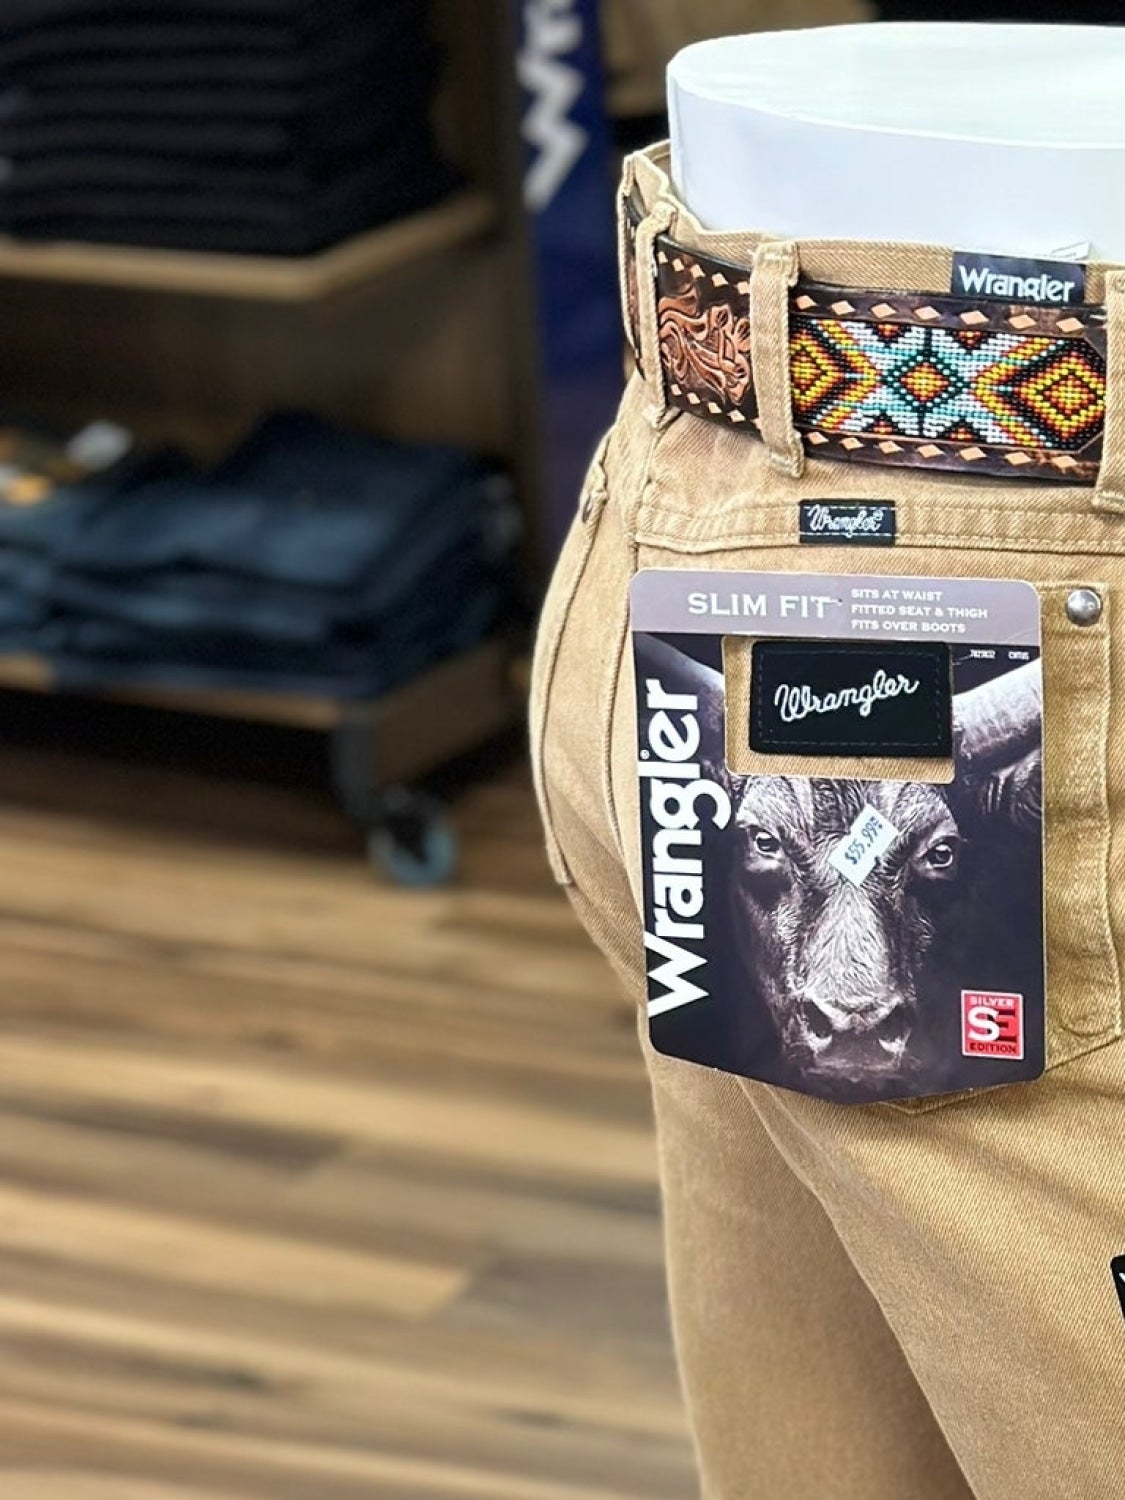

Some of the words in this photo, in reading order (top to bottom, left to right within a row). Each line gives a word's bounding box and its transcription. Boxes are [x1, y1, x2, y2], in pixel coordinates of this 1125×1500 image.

[958, 264, 1075, 302] Wrangler
[688, 592, 767, 616] SLIM
[780, 594, 833, 619] FIT
[851, 588, 880, 599] SITS
[882, 590, 899, 600] AT
[902, 591, 943, 602] WAIST
[851, 604, 895, 616] FITTED
[899, 606, 932, 617] SEAT
[934, 607, 944, 617] &
[947, 607, 988, 619] THIGH
[851, 620, 880, 631] FITS
[883, 621, 918, 632] OVER
[922, 622, 966, 634] BOOTS
[774, 669, 920, 723] Wrangler
[637, 678, 732, 1018] Wrangler
[969, 1043, 1017, 1054] EDITION
